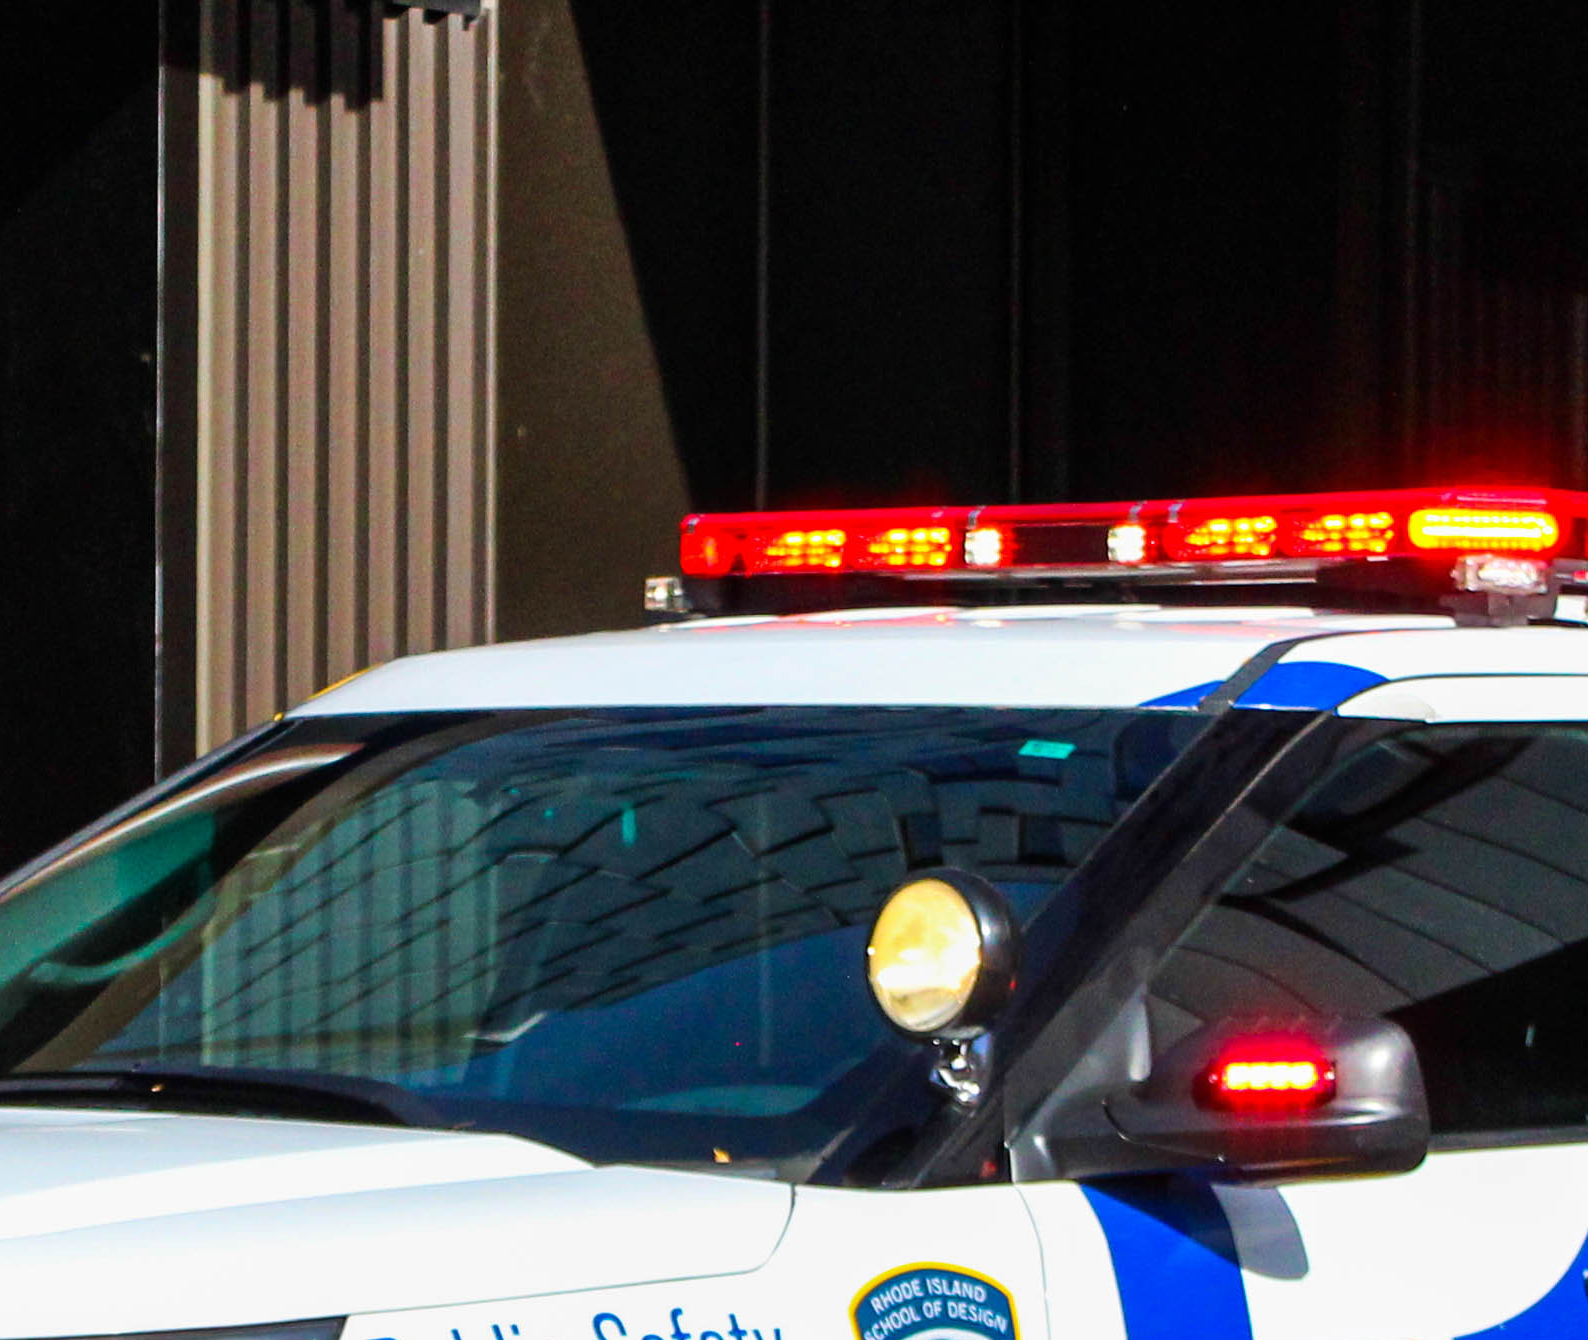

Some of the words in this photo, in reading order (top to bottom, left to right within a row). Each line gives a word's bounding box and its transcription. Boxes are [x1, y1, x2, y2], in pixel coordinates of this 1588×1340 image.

[870, 1278, 924, 1315] RHODE
[926, 1277, 987, 1304] ISLAND
[922, 1299, 942, 1319] OF
[947, 1301, 1008, 1335] DESIGN
